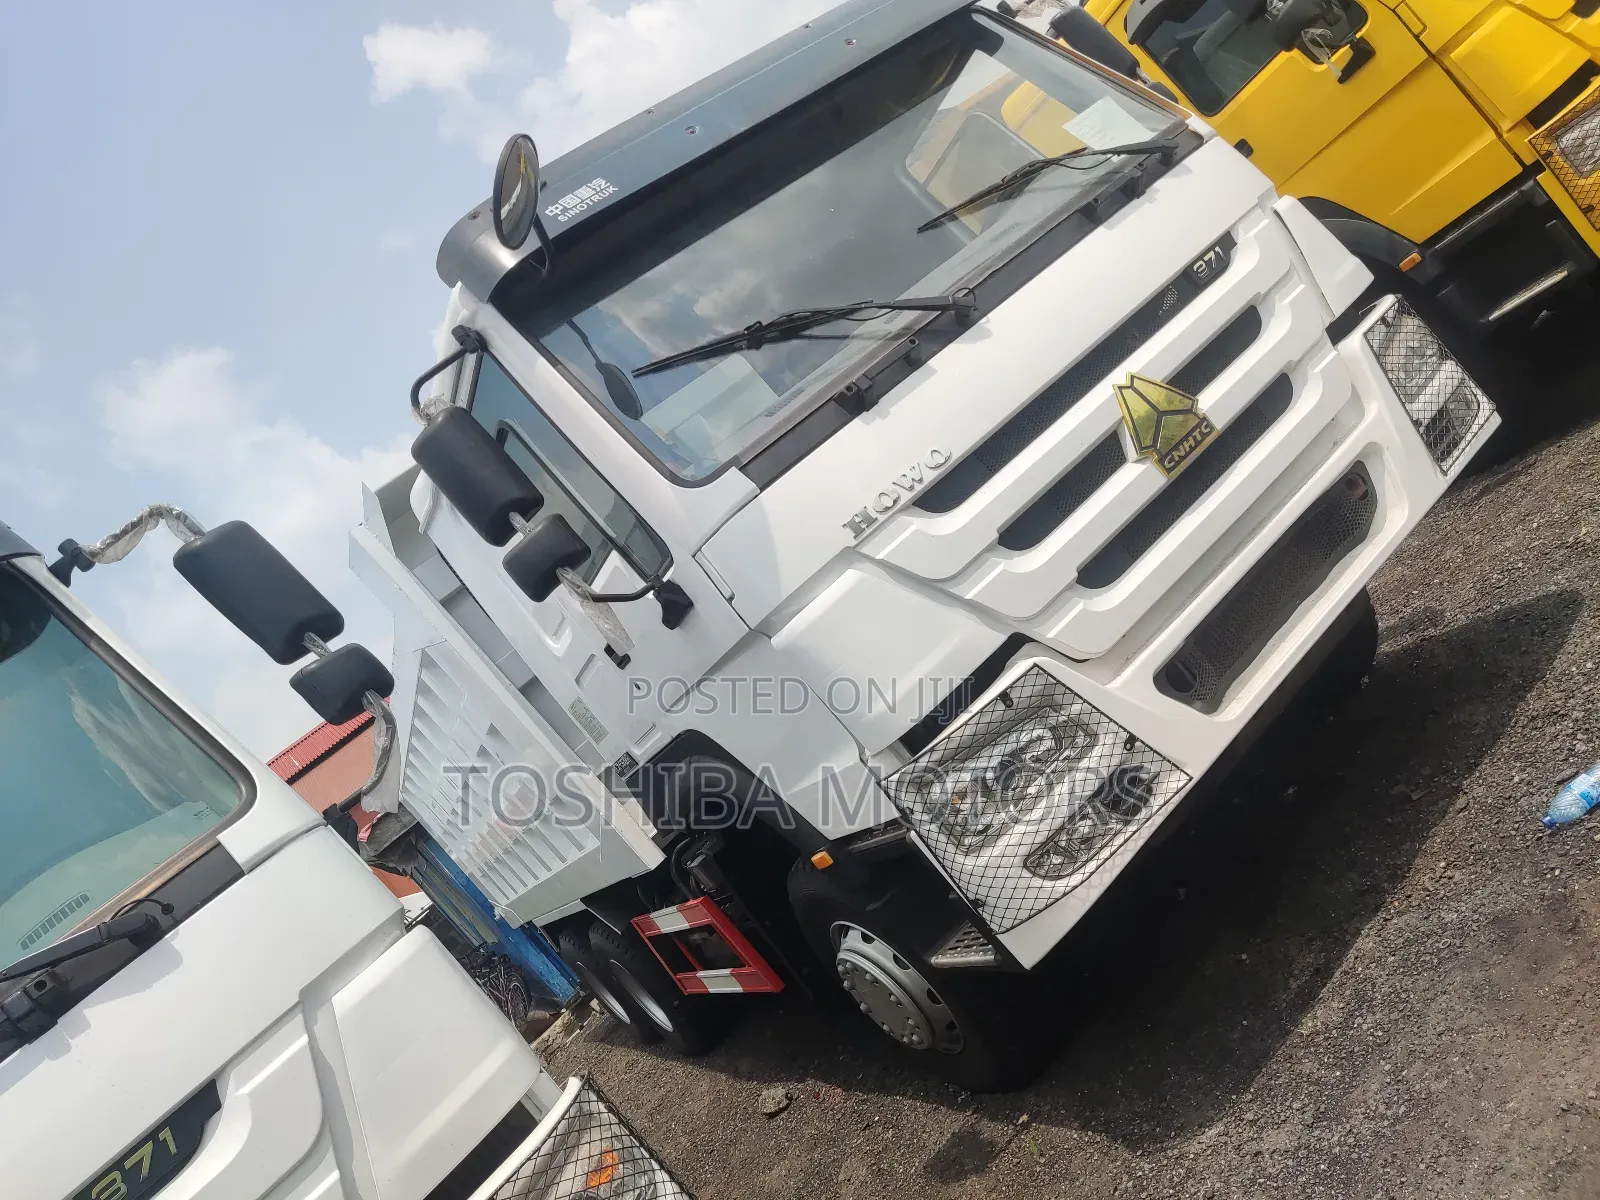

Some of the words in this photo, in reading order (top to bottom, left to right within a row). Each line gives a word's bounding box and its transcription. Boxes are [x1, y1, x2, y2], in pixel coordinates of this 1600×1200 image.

[545, 177, 610, 216] 中国重汽
[557, 185, 618, 222] SINOTRUK
[1193, 245, 1228, 279] 371
[1164, 420, 1210, 469] CNHTC
[841, 446, 952, 541] HOWO
[91, 1126, 178, 1200] 371
